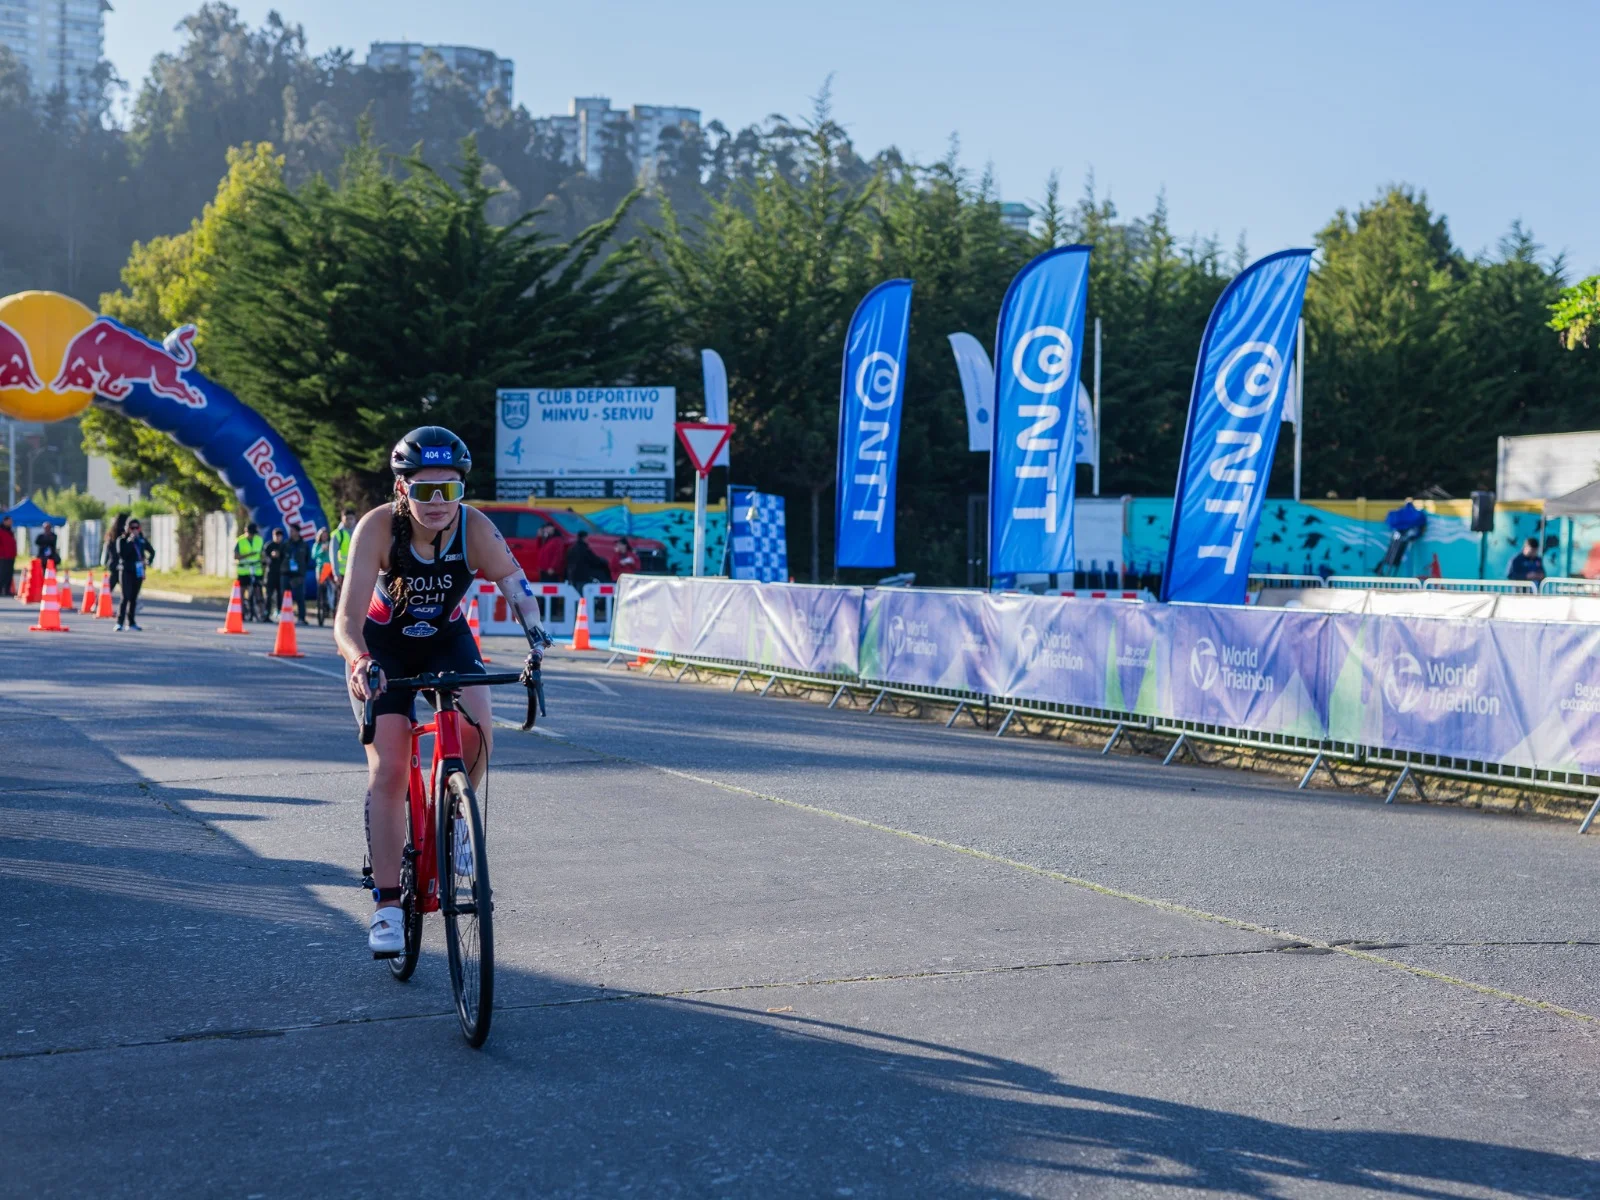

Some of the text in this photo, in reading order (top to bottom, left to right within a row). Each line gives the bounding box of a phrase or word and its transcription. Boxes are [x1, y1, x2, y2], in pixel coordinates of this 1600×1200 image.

[537, 388, 660, 405] CLUB DEPORTIVO
[542, 407, 589, 421] MINVU
[602, 406, 654, 421] SERVIU
[424, 450, 439, 459] 404
[853, 420, 890, 534] NTT
[1012, 404, 1062, 534] NTT
[244, 437, 317, 541] Red Bull
[1198, 430, 1262, 575] NTT
[409, 592, 446, 606] CHI
[1222, 645, 1258, 668] World
[1222, 669, 1274, 693] Triathlon
[1426, 661, 1478, 688] World
[1427, 687, 1500, 716] Triathlon
